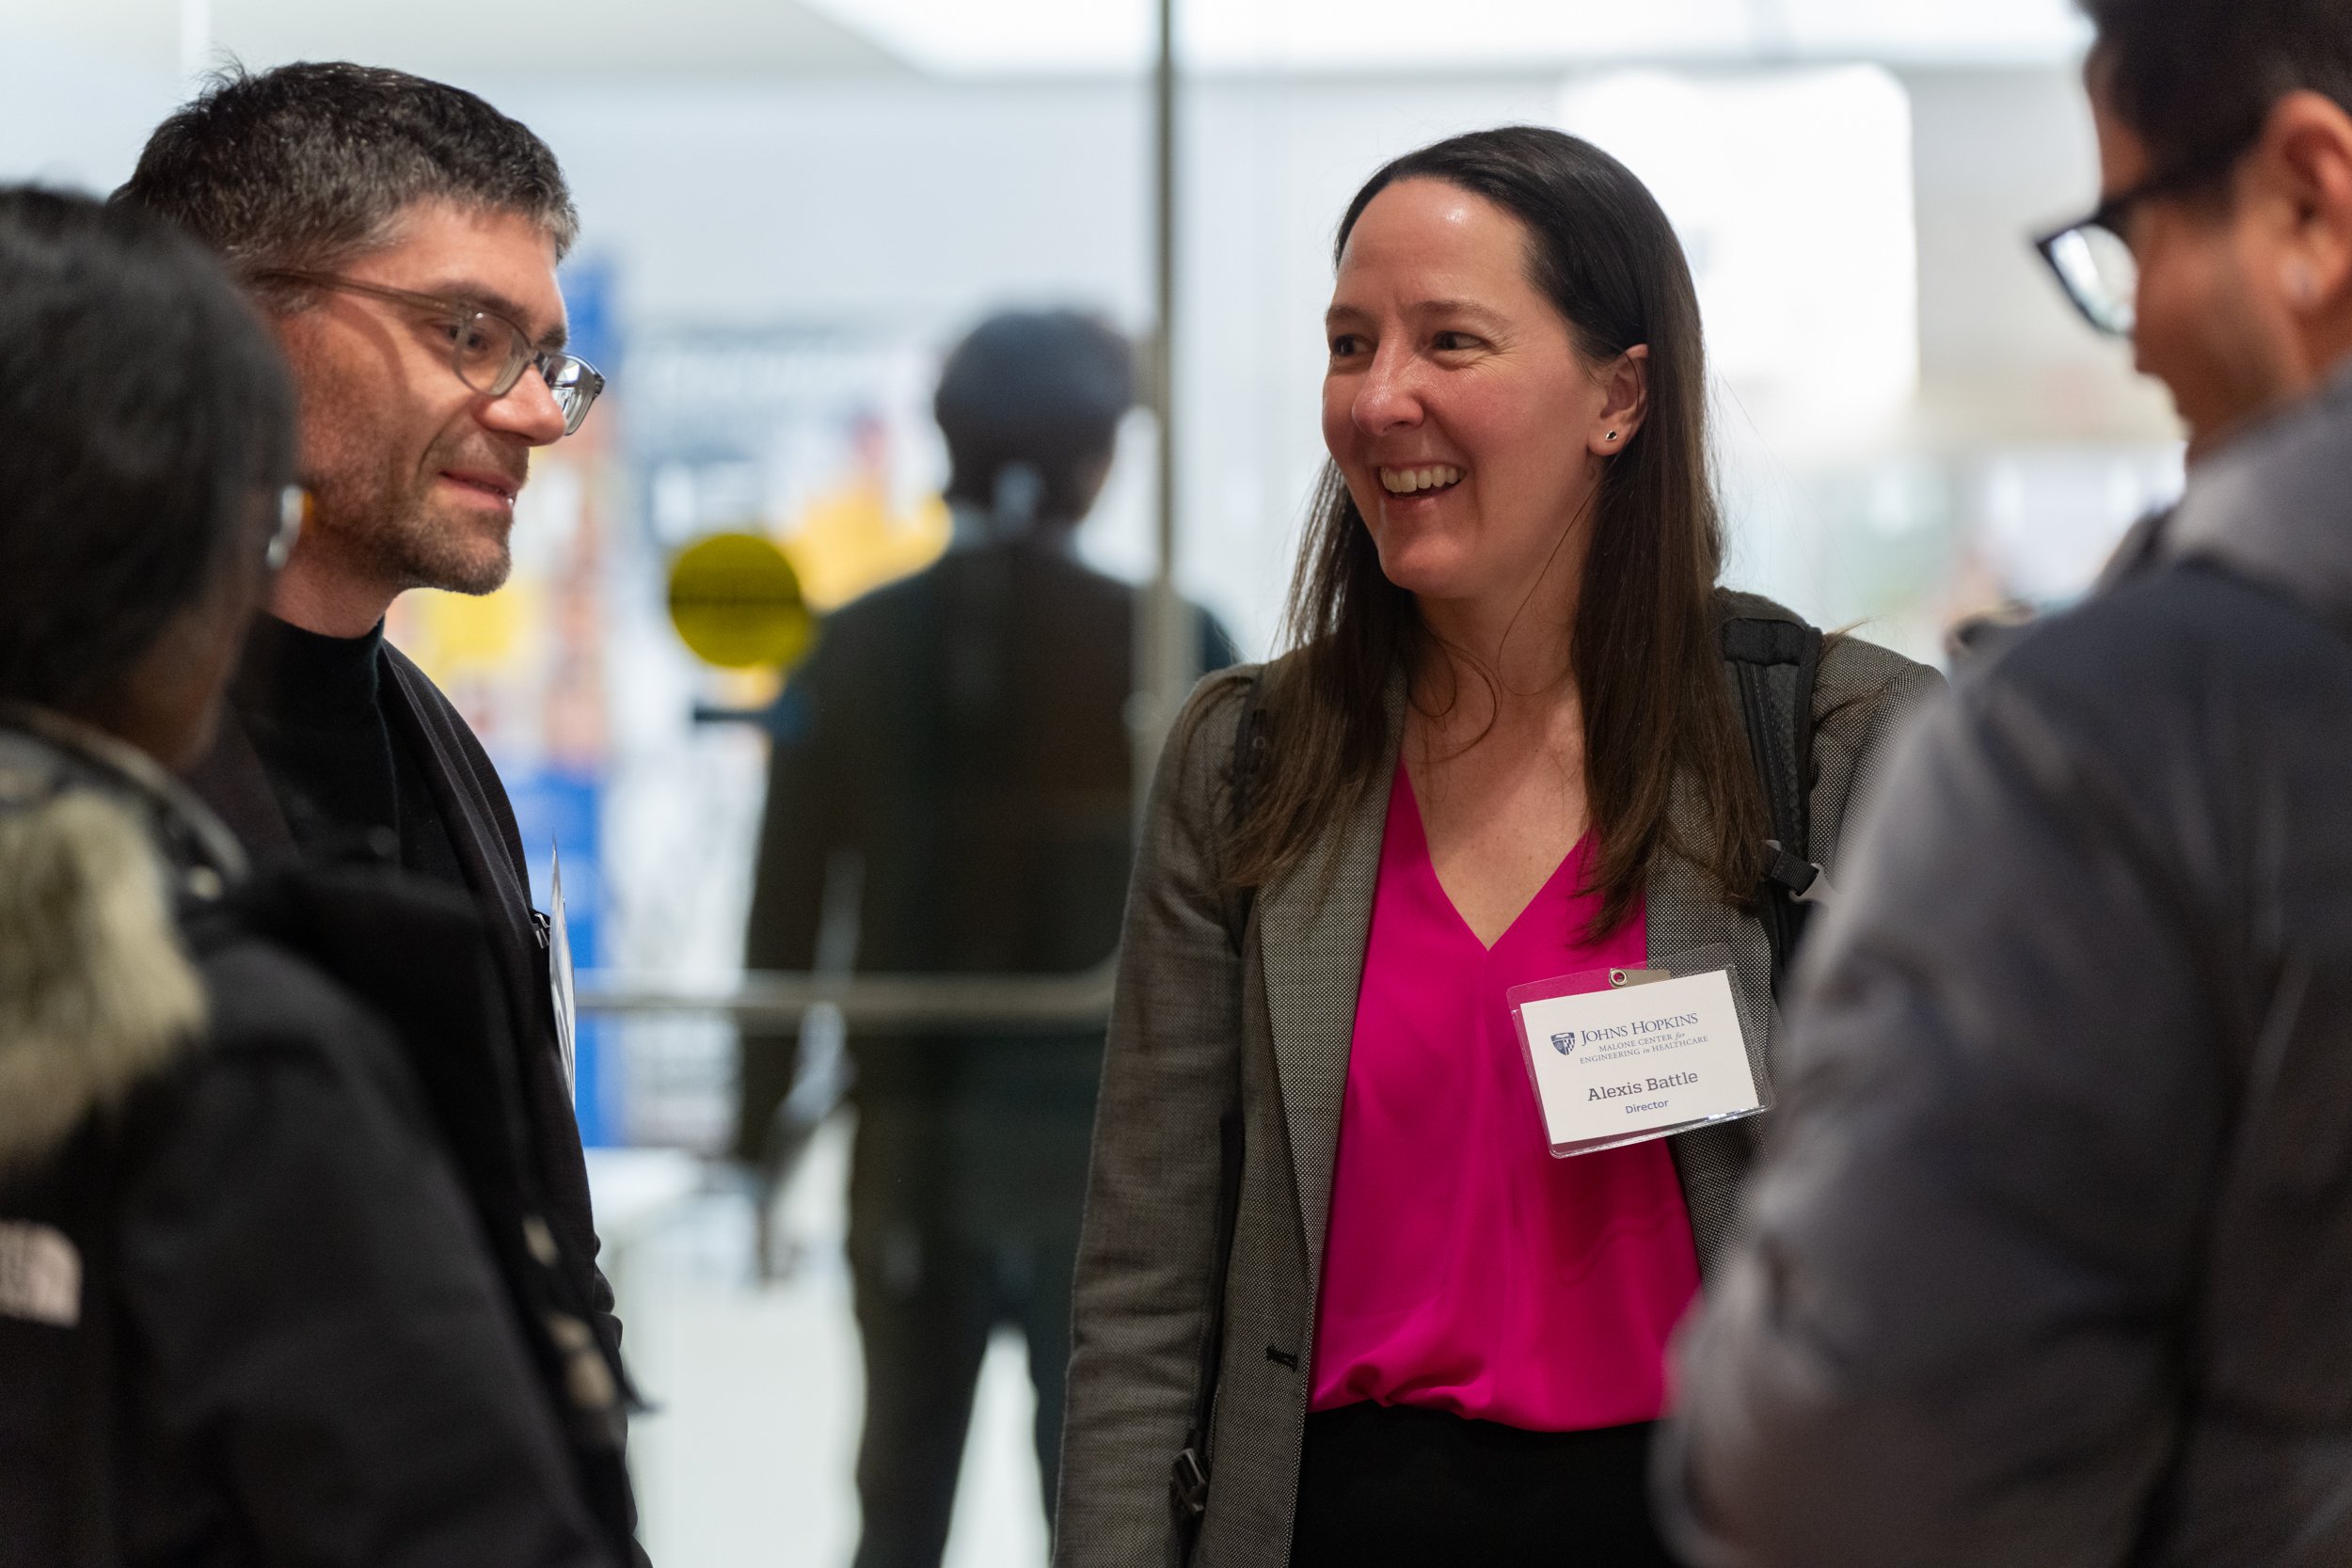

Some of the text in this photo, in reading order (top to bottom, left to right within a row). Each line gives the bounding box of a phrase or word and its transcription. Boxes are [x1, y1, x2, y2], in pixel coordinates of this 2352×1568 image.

[1581, 1013, 1698, 1046] JOHNS HOPKINS
[1599, 1032, 1686, 1053] MALONE CENTER for
[1580, 1048, 1640, 1064] ENGINEERING
[1651, 1036, 1708, 1053] HEALTHCARE
[1588, 1071, 1698, 1101] Alexis Battle
[1625, 1100, 1669, 1114] Director
